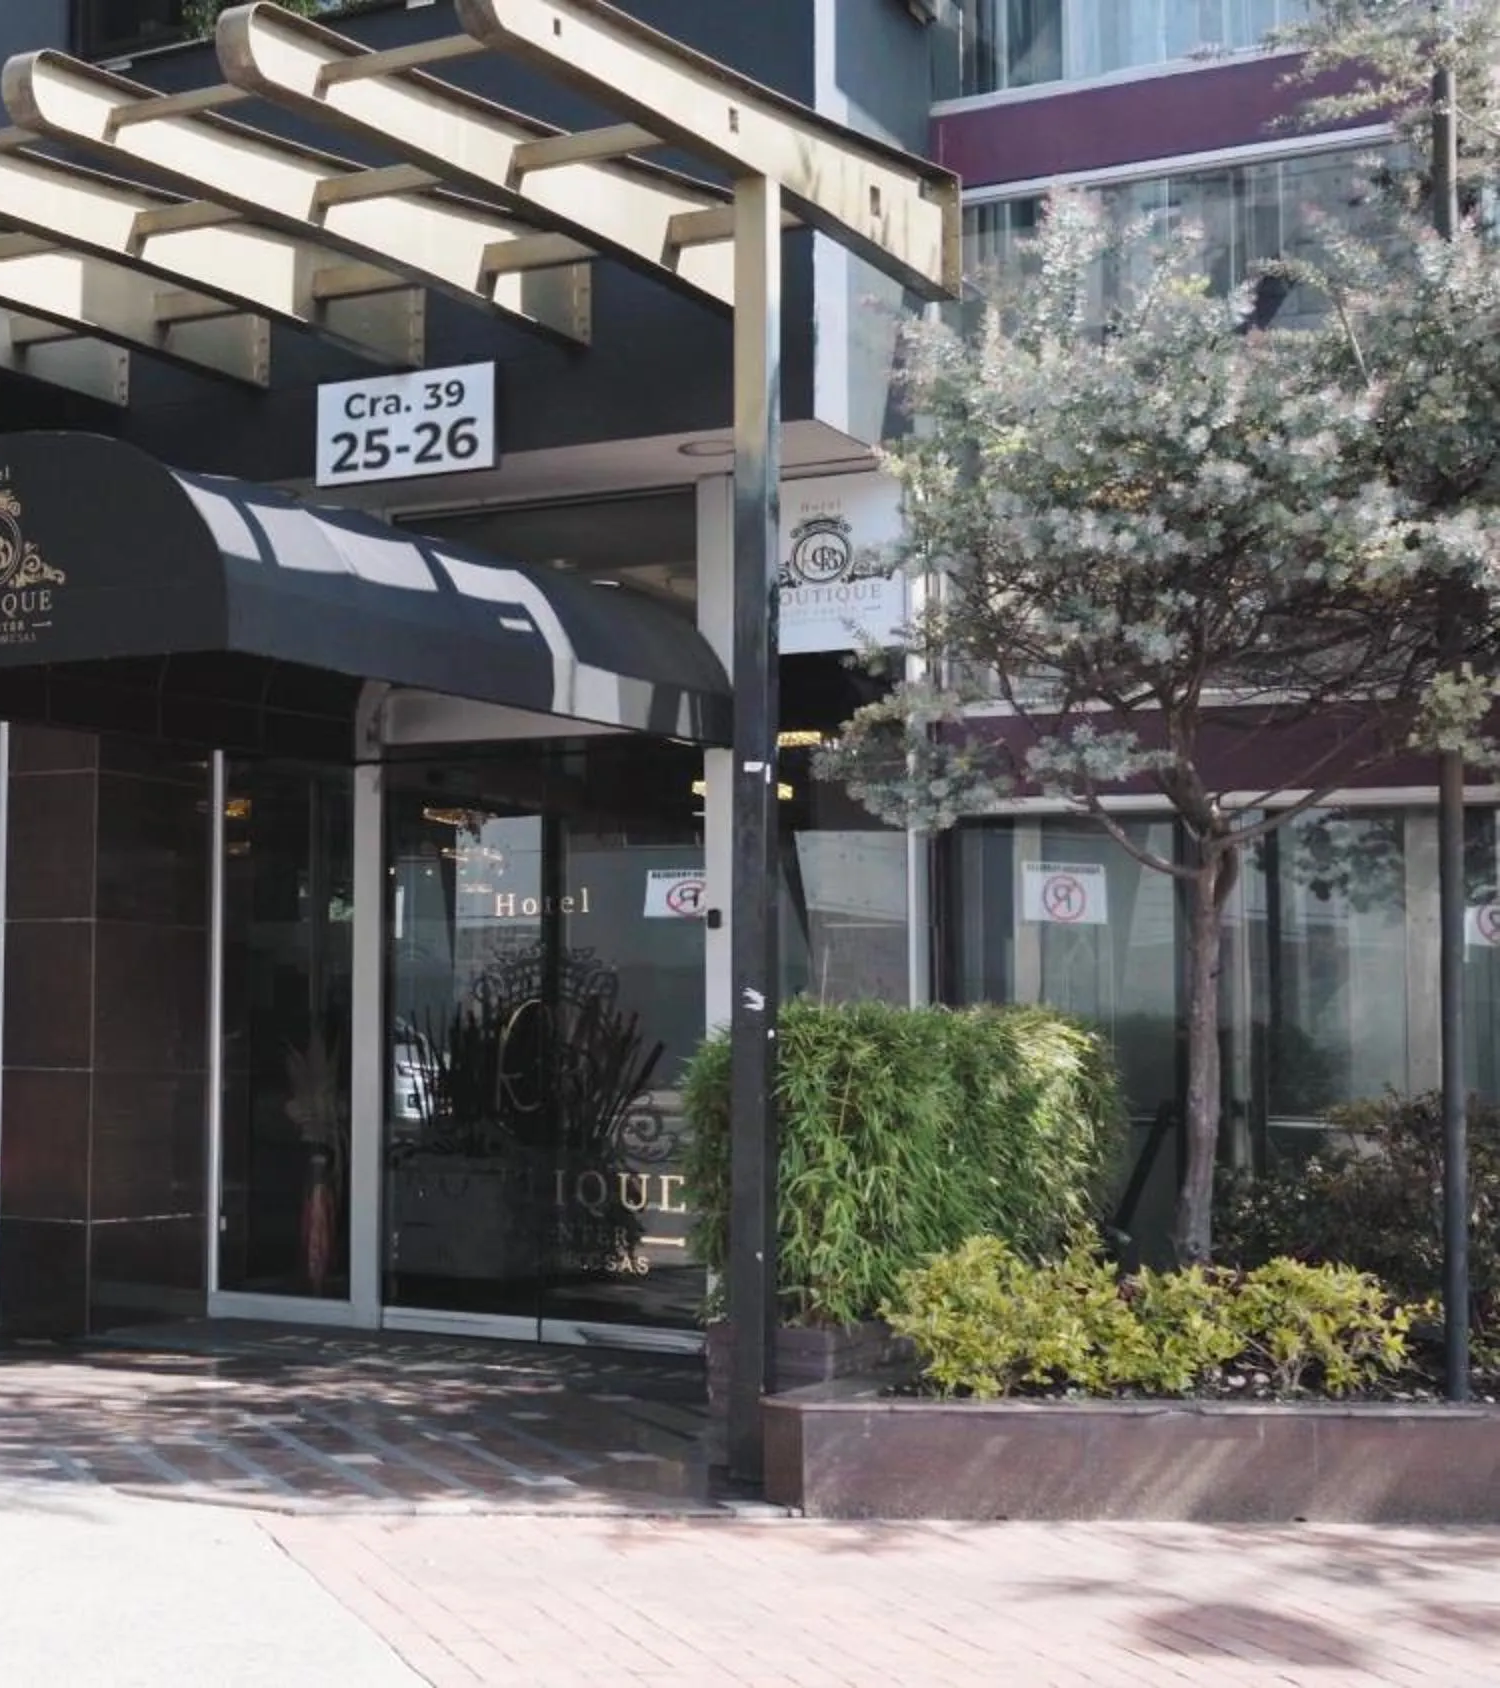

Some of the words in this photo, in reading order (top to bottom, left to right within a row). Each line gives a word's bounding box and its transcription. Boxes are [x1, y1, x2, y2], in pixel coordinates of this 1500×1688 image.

[344, 391, 413, 421] Cra.
[423, 379, 467, 411] 39
[330, 416, 479, 475] 25-26
[779, 583, 882, 608] OUTIQUE
[495, 886, 590, 917] Hotel
[554, 1169, 687, 1217] IQUE
